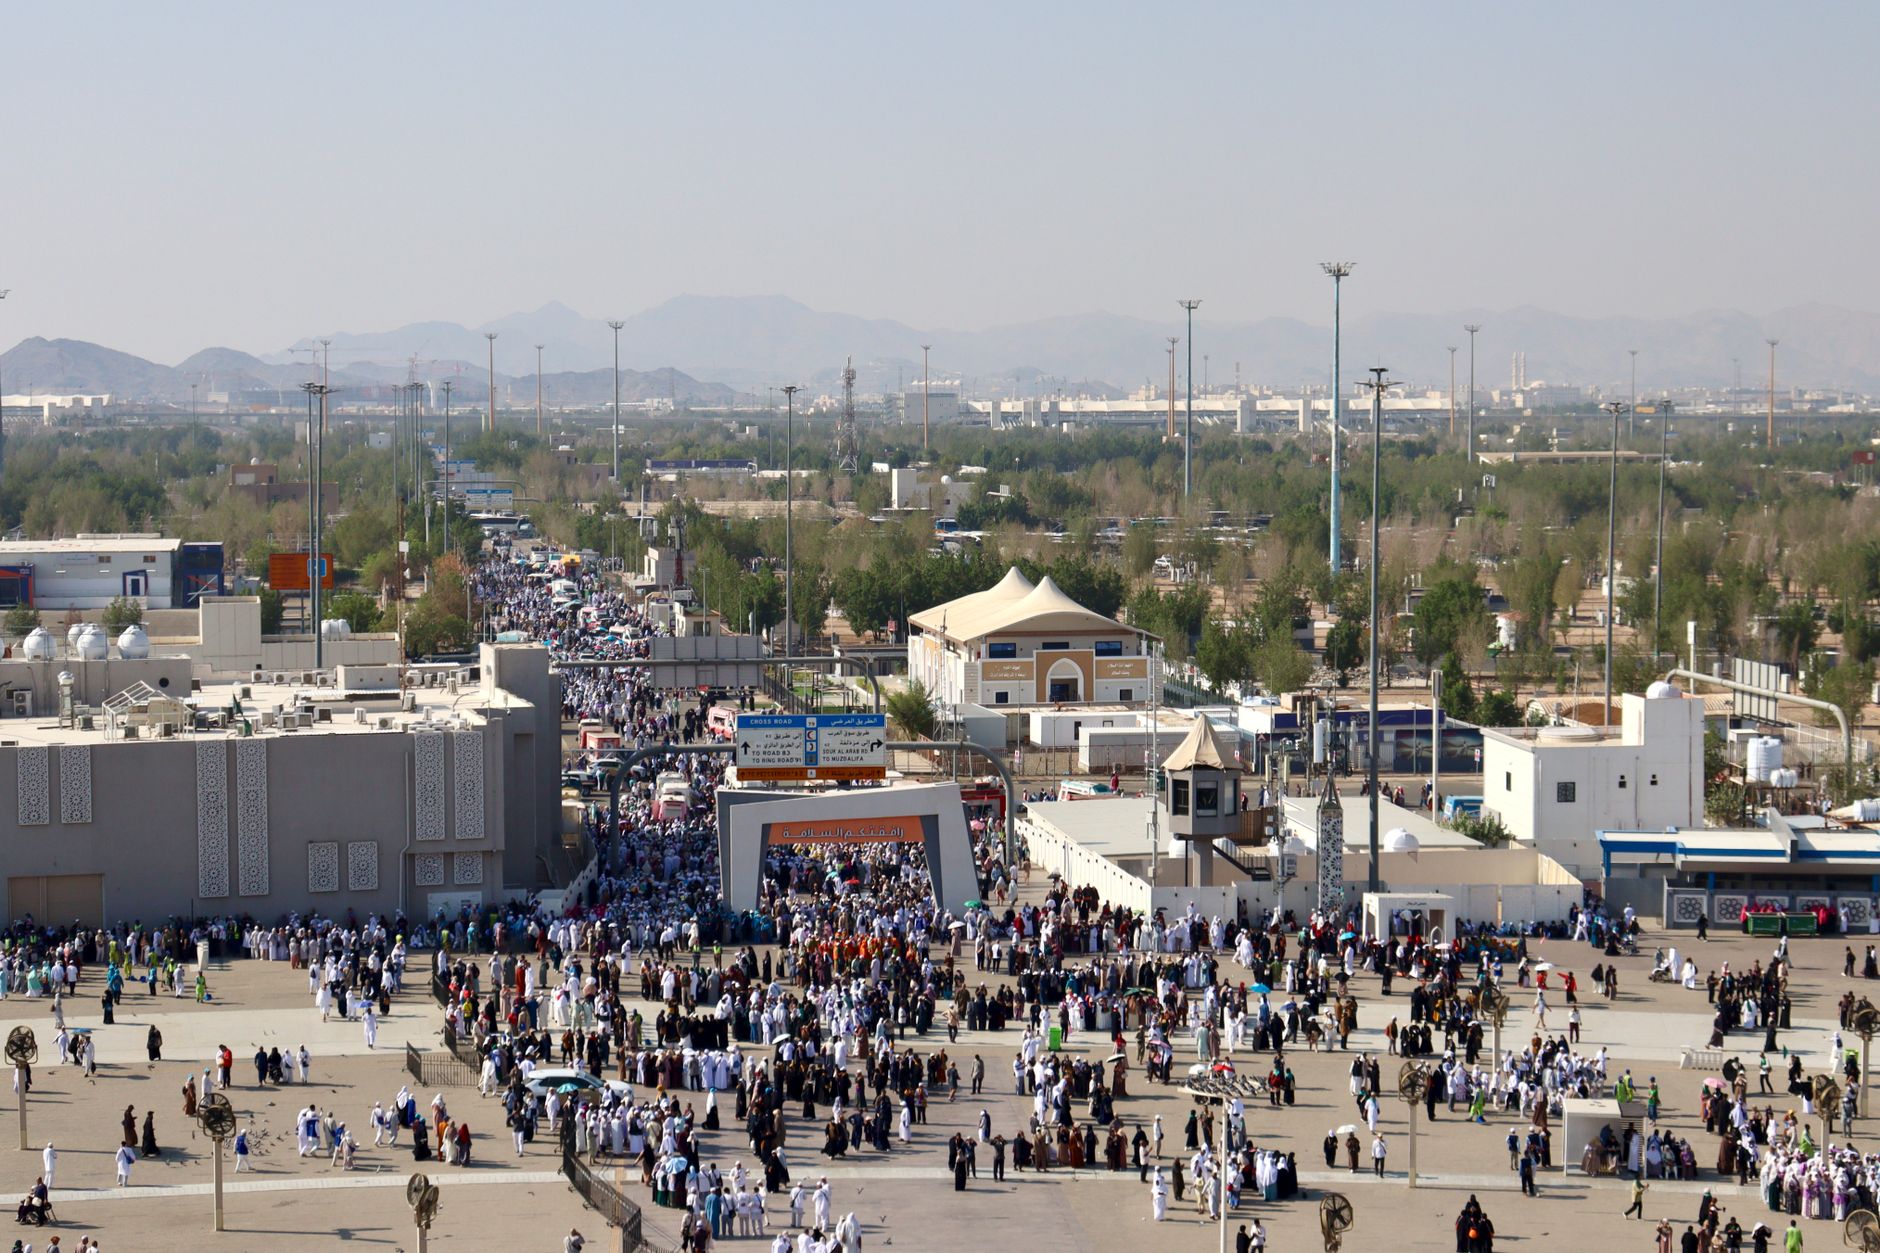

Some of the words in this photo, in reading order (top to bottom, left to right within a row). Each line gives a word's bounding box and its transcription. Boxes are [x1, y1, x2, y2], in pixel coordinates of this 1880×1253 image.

[831, 718, 855, 727] العرضي
[856, 718, 877, 726] الطريق
[783, 826, 844, 838] السلامة
